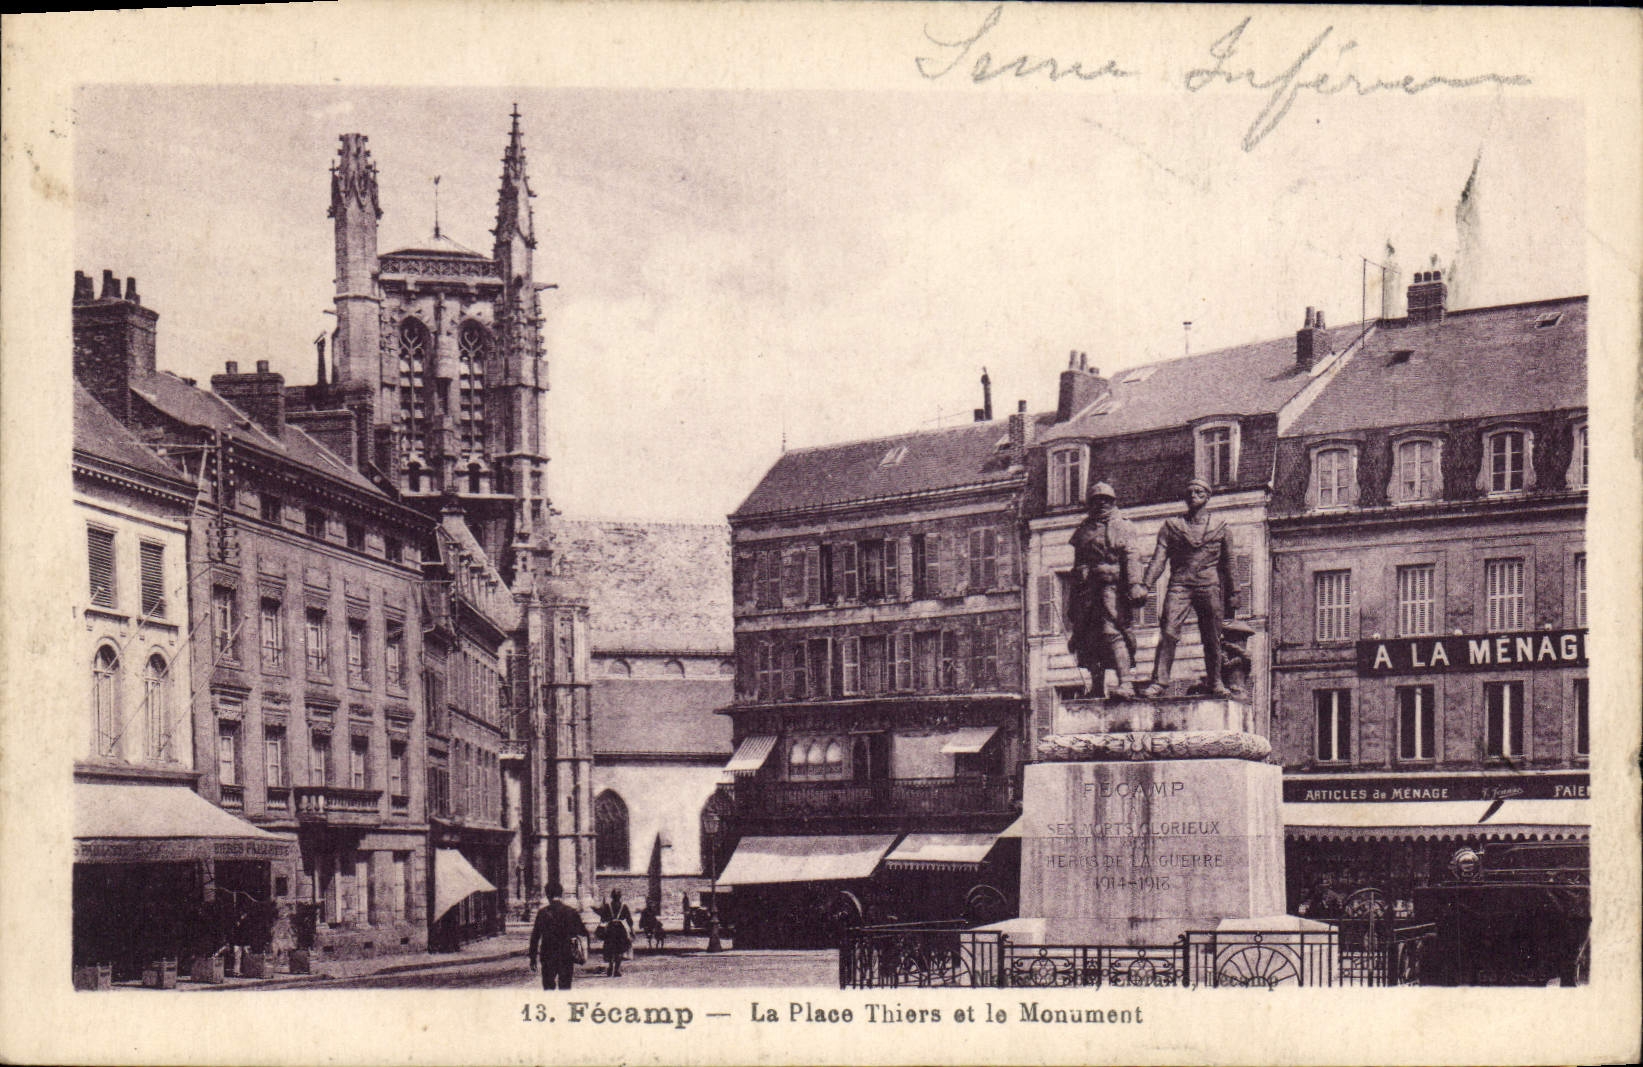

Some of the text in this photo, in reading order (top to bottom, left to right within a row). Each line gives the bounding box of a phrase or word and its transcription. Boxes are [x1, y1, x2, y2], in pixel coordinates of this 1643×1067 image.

[1373, 644, 1393, 669] A
[1411, 641, 1450, 668] LA
[1305, 789, 1368, 800] ARTICLES
[1373, 789, 1387, 799] de
[1047, 821, 1220, 836] SES MORTS GLORIEUX
[1106, 854, 1124, 869] DE
[1131, 854, 1151, 869] LA
[1159, 854, 1224, 868] GUERRE
